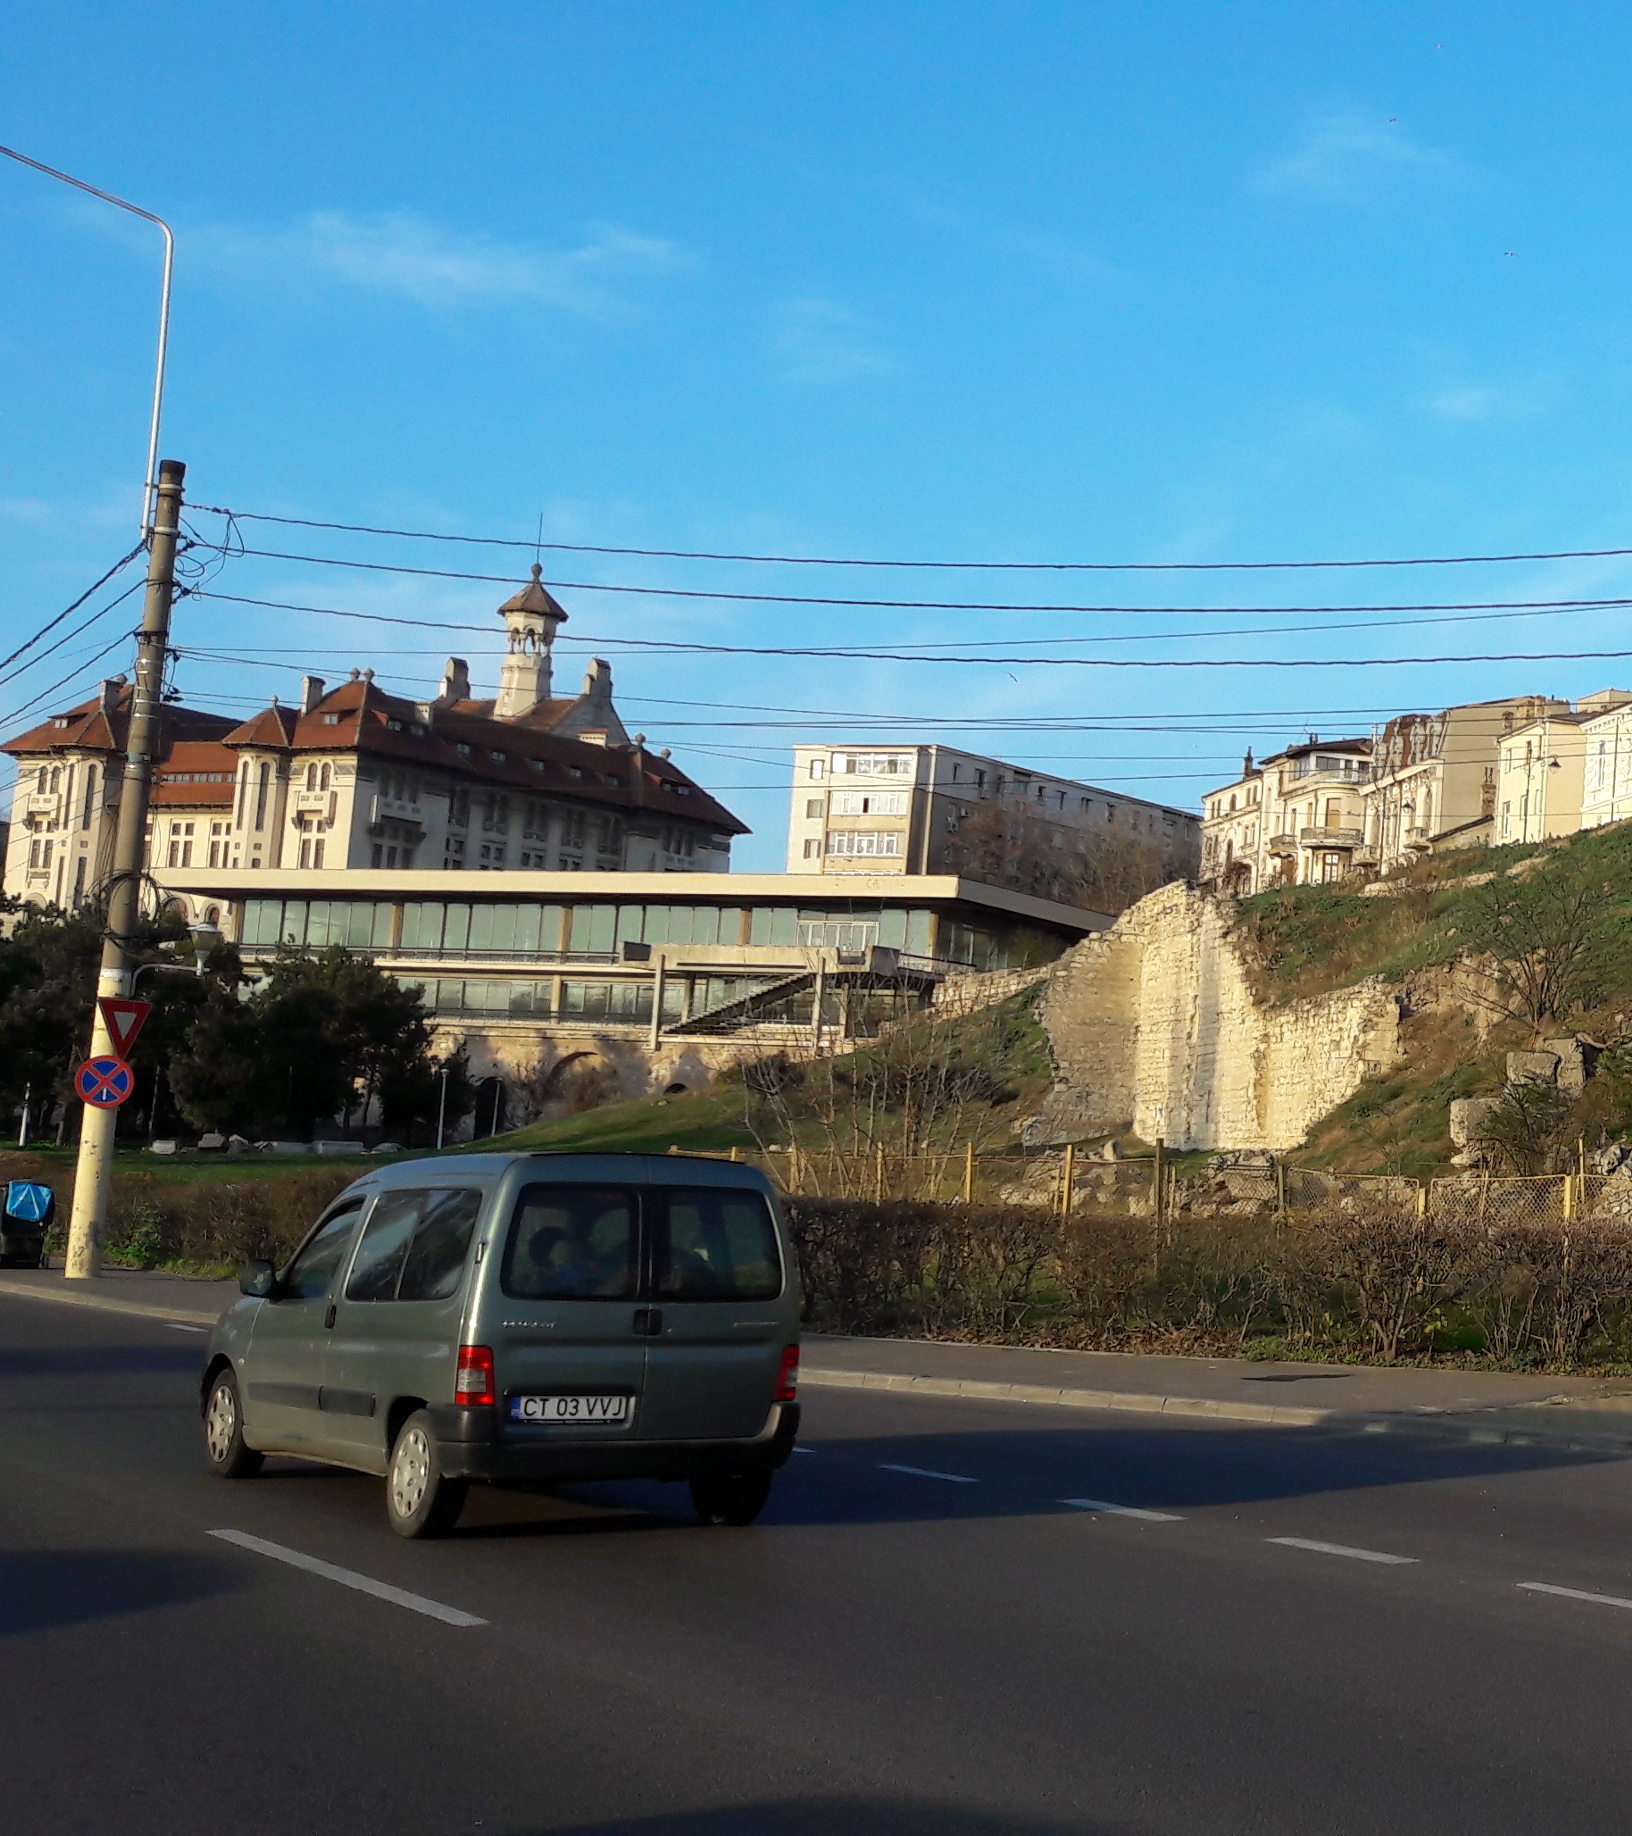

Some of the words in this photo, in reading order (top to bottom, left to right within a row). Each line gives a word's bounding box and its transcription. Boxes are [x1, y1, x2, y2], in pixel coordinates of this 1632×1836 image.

[524, 1398, 550, 1417] CT
[556, 1398, 580, 1417] 03
[586, 1398, 623, 1417] VVJ
